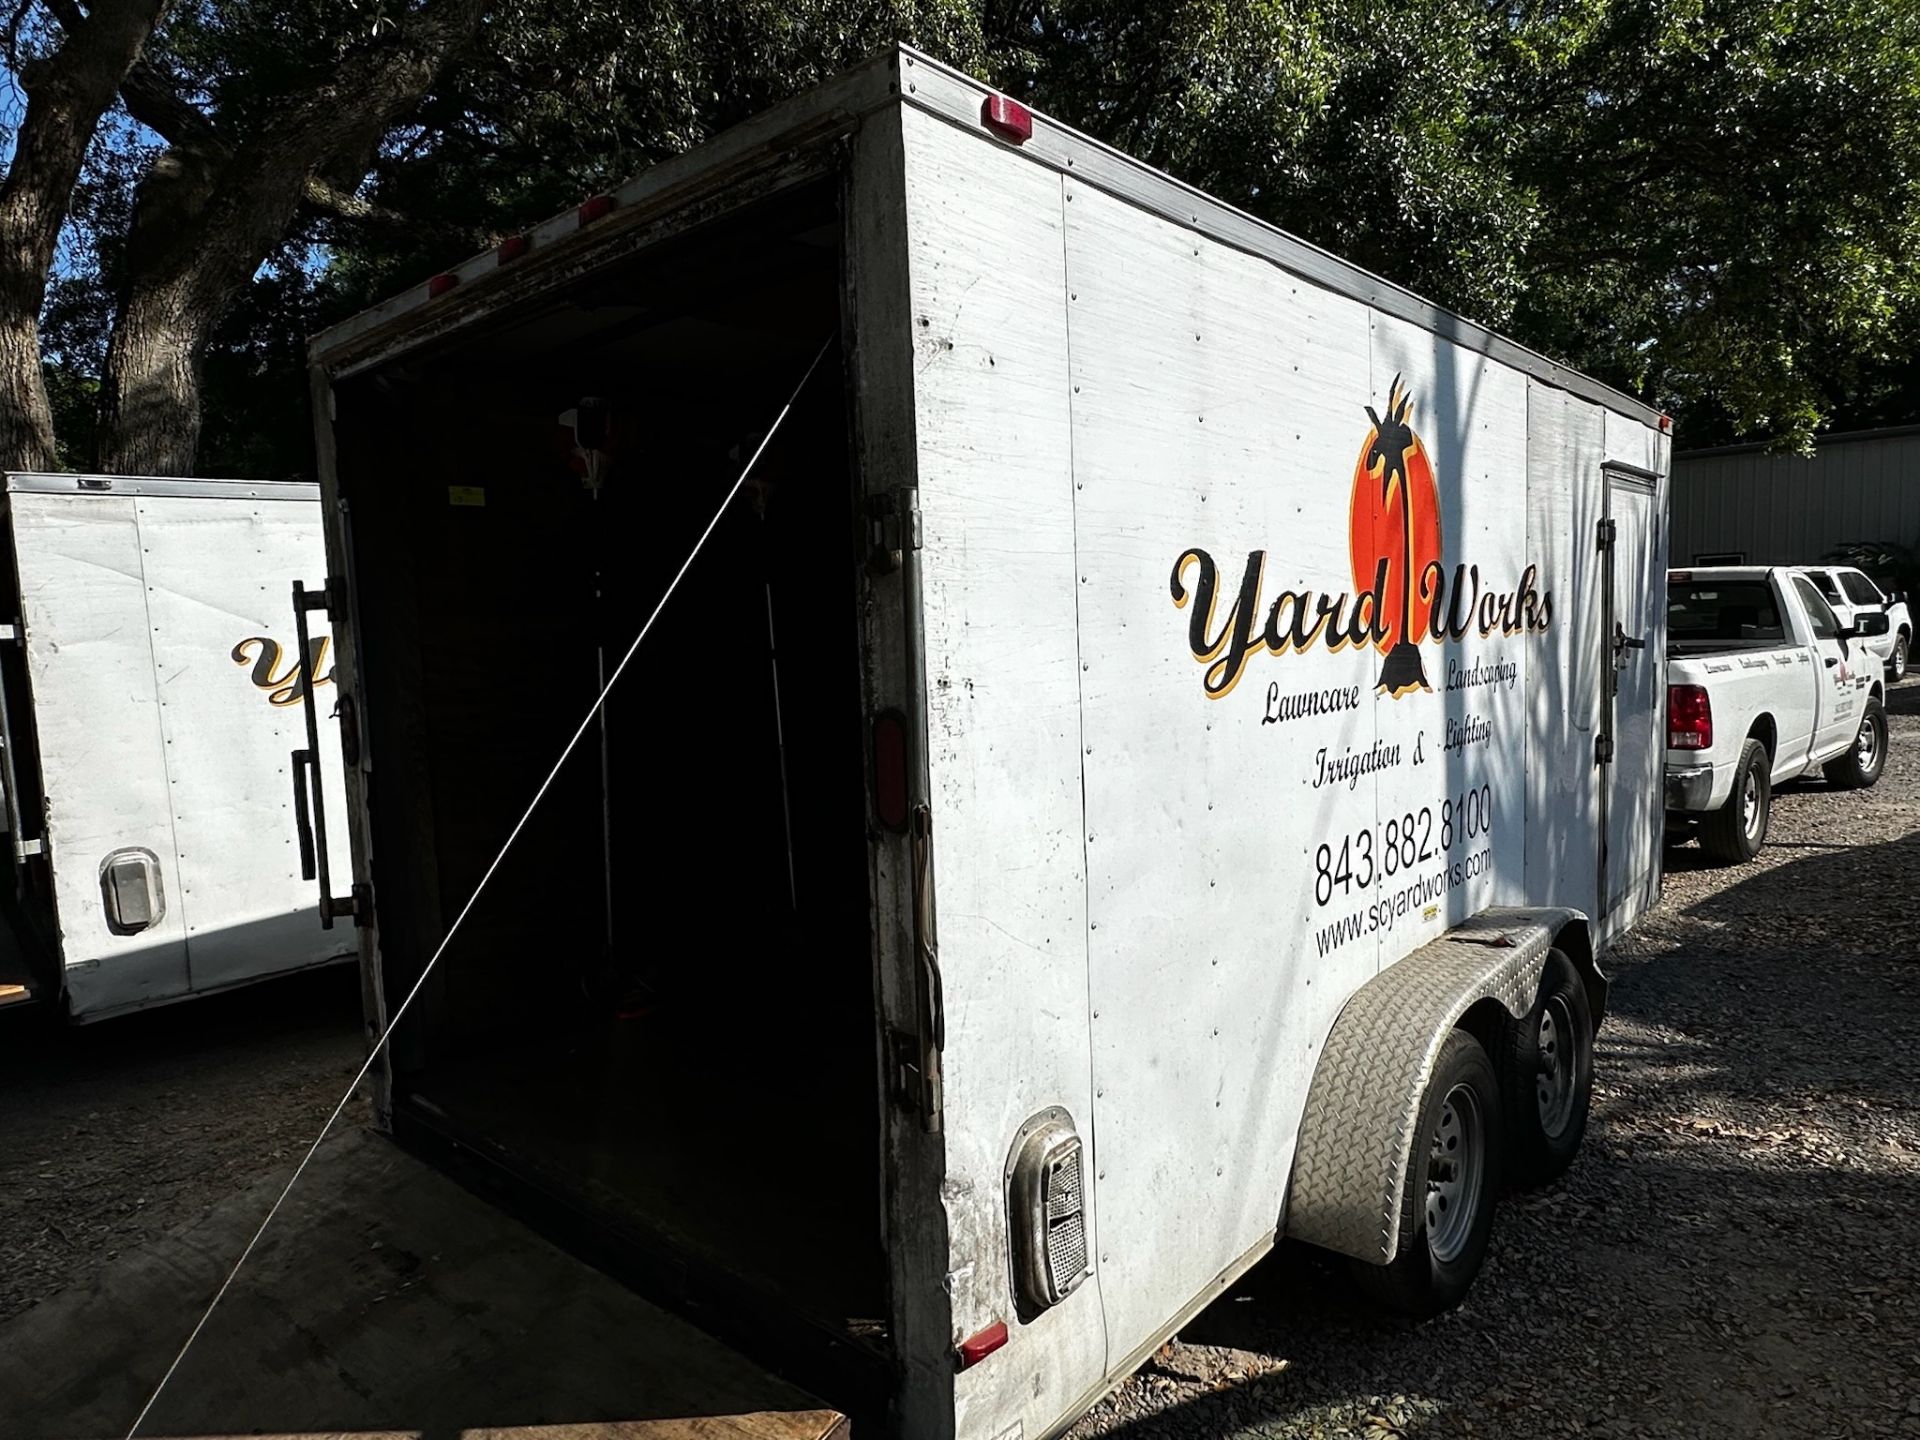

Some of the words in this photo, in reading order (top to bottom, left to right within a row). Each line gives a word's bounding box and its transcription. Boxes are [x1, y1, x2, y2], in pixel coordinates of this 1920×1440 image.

[1170, 547, 1391, 700] Yard
[1419, 560, 1553, 643] Works
[1261, 680, 1360, 727] Lawncare
[1445, 654, 1518, 692] Landscaping
[1312, 738, 1402, 791] Irrigation
[1412, 730, 1426, 767] &
[1443, 714, 1492, 758] Lighting
[1315, 783, 1492, 907] 843.882.8100
[1315, 846, 1492, 958] www.scyardworks.com
